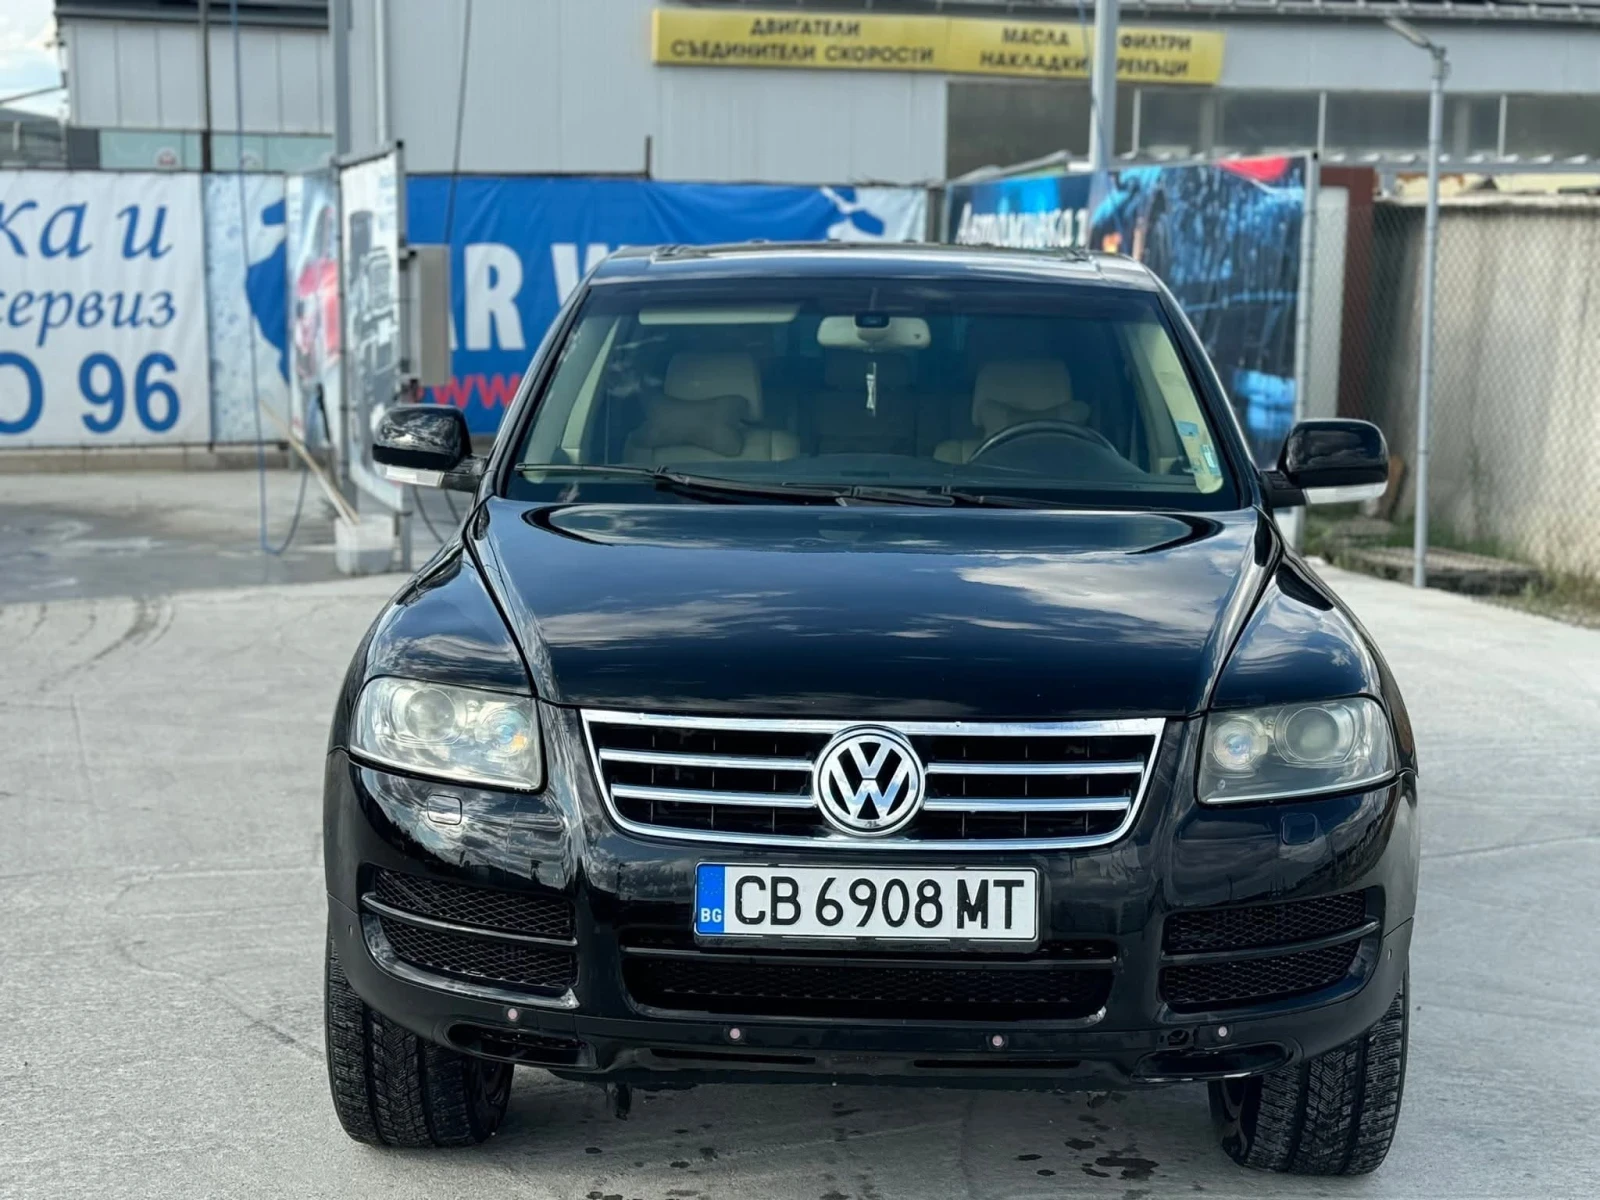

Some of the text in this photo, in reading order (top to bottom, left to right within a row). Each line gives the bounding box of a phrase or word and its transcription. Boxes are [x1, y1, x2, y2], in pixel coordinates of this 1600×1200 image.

[750, 18, 861, 37] ДВИГАТЕЛИ
[1003, 27, 1192, 53] МАСЛА ФИЛТРИ
[671, 39, 934, 64] СЪЕДИНИТЕЛИ СКОРОСТИ
[980, 50, 1089, 73] НАКЛАДКИ
[117, 204, 173, 260] и
[0, 289, 176, 348] ервиз
[78, 351, 180, 434] 96
[700, 907, 722, 924] BG
[735, 875, 1025, 930] CB 6908 MT
